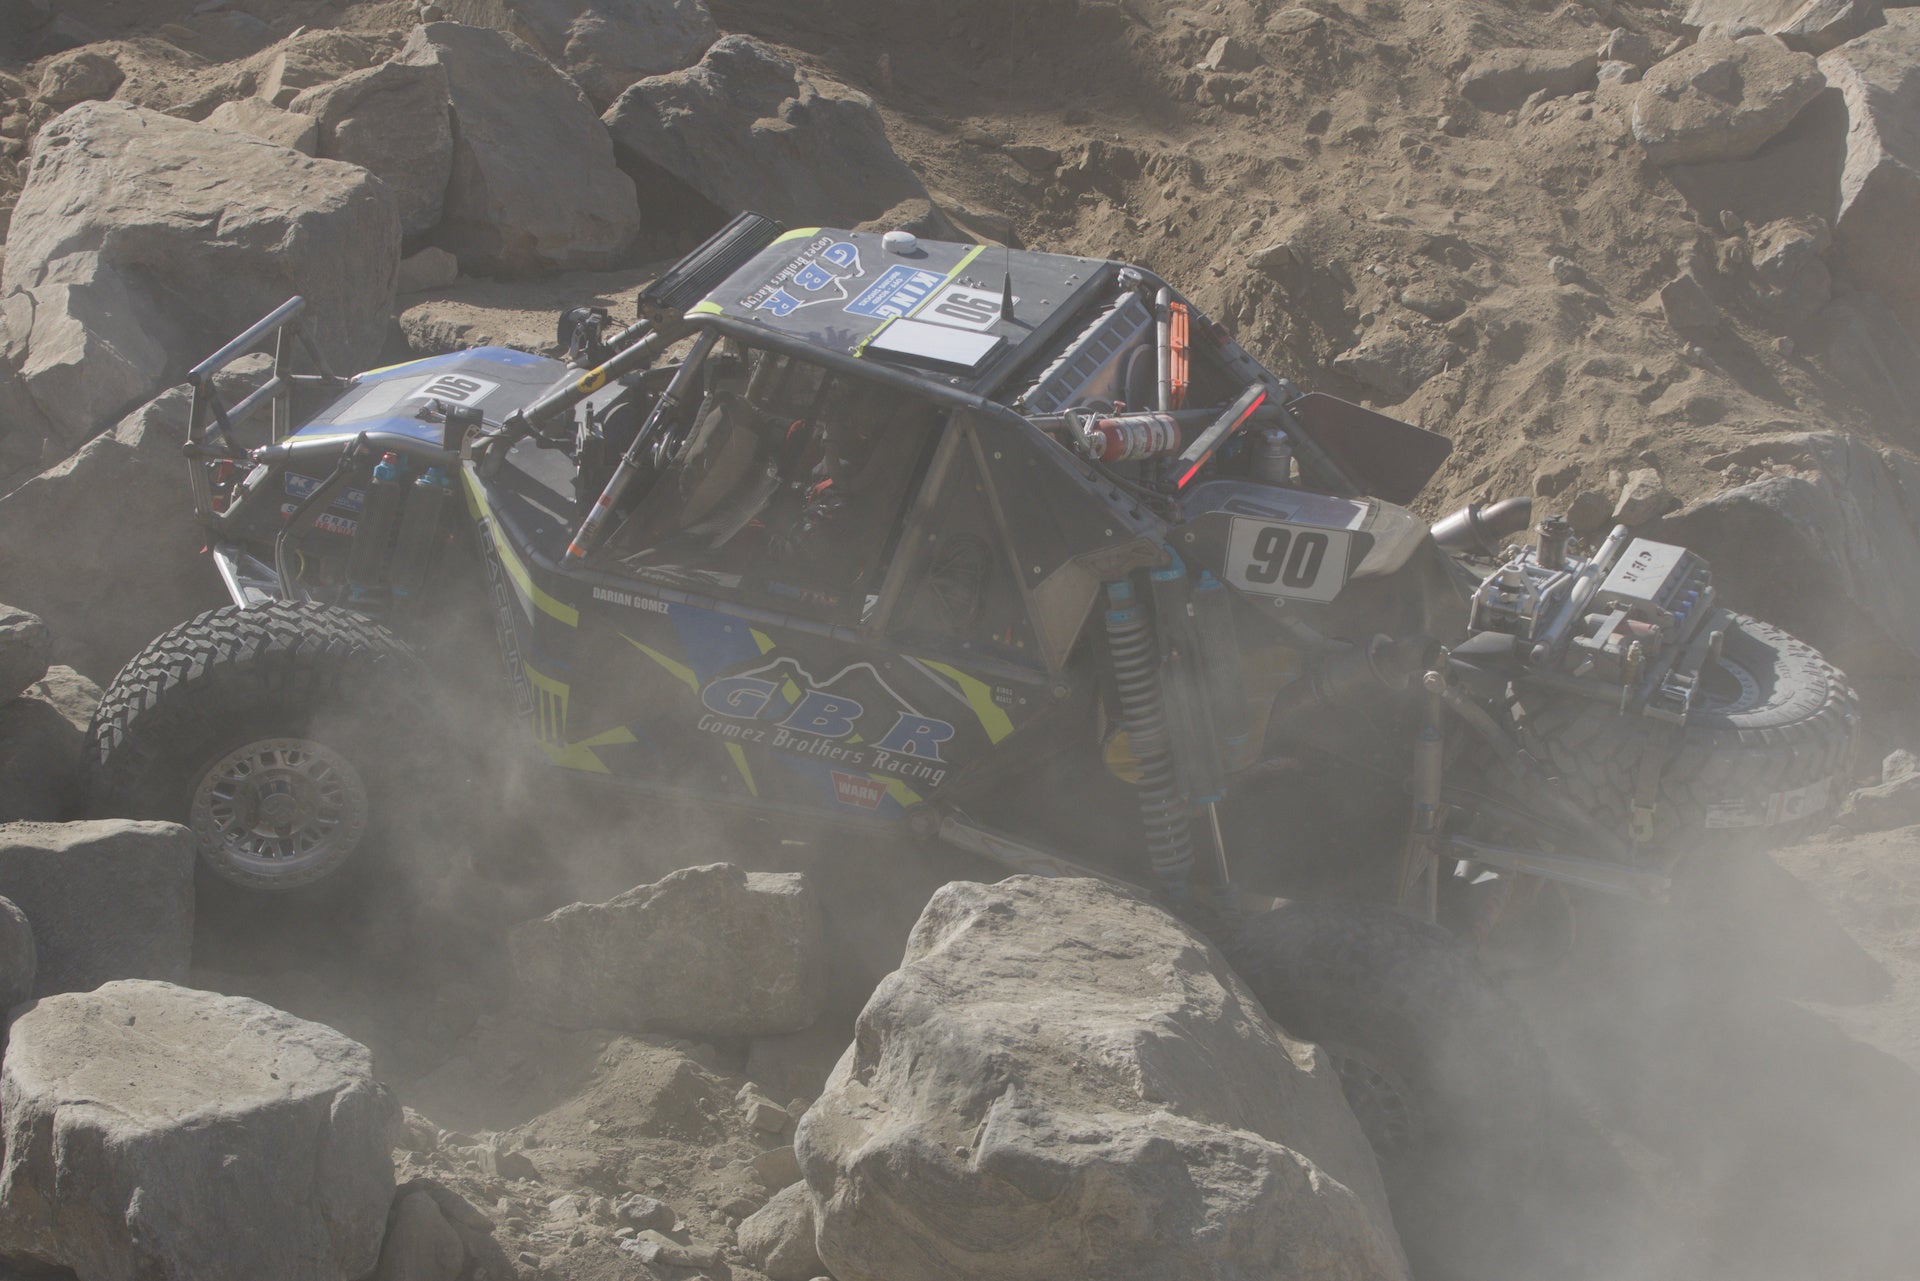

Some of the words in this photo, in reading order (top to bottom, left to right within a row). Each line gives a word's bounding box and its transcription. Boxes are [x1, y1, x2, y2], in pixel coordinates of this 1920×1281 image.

[754, 241, 860, 317] GBR
[875, 271, 939, 318] KING
[934, 293, 1001, 324] 90
[424, 376, 481, 401] 90
[1245, 526, 1329, 589] 90
[481, 528, 529, 706] RACELINE
[592, 586, 633, 607] DARIAN
[633, 595, 669, 615] GOMEZ
[702, 675, 955, 764] GBR
[698, 714, 767, 743] Gomez
[773, 728, 864, 764] Brothers
[871, 750, 947, 787] Racing
[838, 780, 878, 802] WARN
